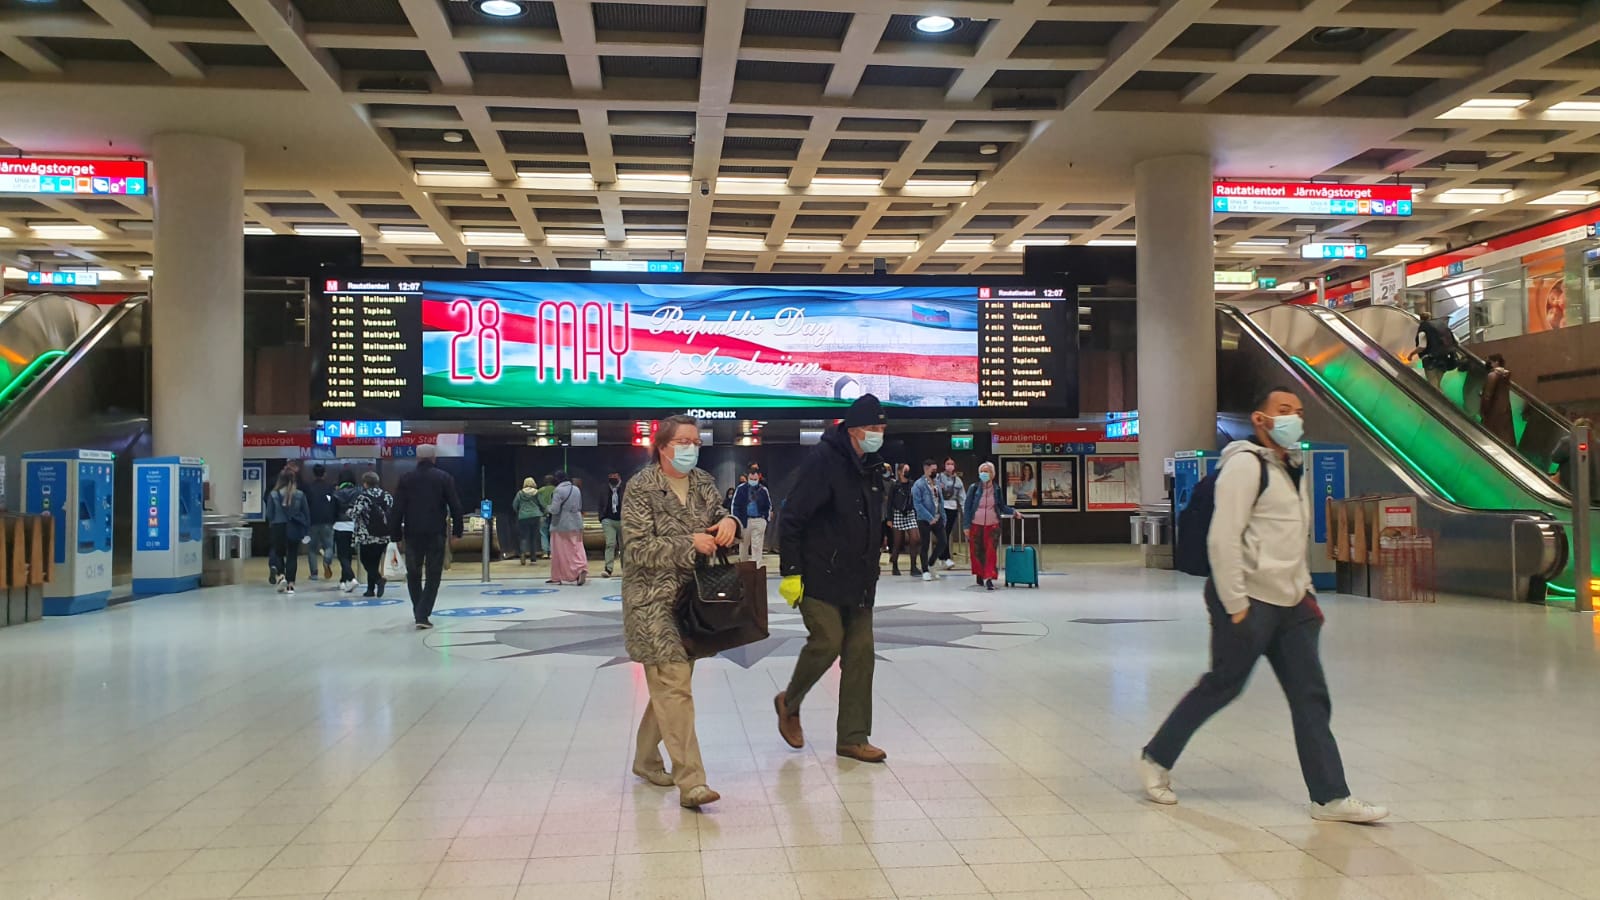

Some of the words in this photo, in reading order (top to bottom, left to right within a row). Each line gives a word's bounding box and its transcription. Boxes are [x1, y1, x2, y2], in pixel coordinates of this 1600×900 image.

[0, 161, 95, 175] ärnvägstorget
[1216, 185, 1286, 196] Rautatientori
[1293, 187, 1372, 199] Järnvägstorget
[398, 282, 421, 291] 12:07
[1043, 289, 1064, 297] 12:07
[339, 295, 354, 303] min
[339, 306, 354, 314] min
[362, 306, 392, 316] Tapiola
[339, 318, 354, 326] min
[362, 318, 396, 326] Vuosaari
[649, 305, 764, 345] Republic
[773, 306, 833, 347] Day
[339, 330, 354, 338] min
[450, 298, 501, 382] 28
[537, 299, 630, 382] MAY
[339, 342, 354, 350] min
[339, 354, 354, 362] min
[362, 354, 392, 364] Tapiola
[339, 366, 354, 374] min
[362, 366, 396, 374] Vuosaari
[649, 348, 681, 385] of
[680, 346, 823, 387] Azerbaijan
[339, 378, 354, 386] min
[339, 390, 354, 398] min
[684, 408, 737, 419] JCDecaux
[342, 422, 356, 434] M
